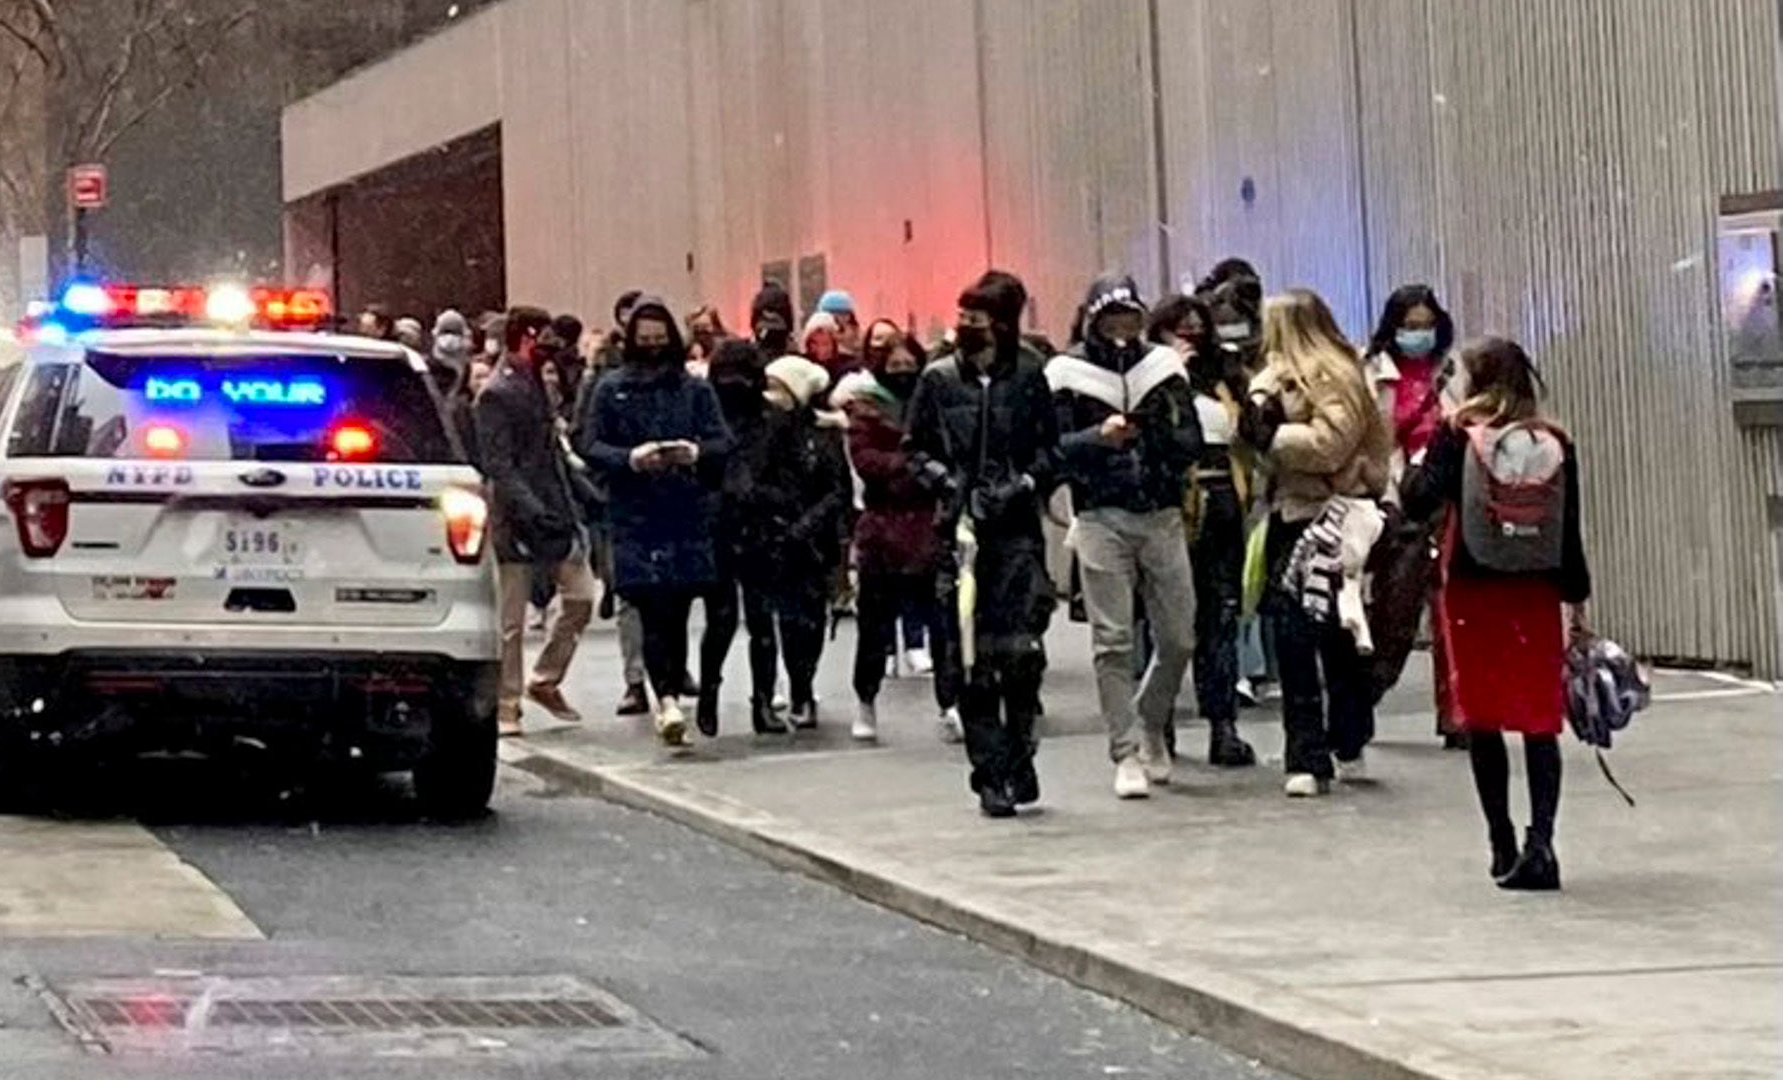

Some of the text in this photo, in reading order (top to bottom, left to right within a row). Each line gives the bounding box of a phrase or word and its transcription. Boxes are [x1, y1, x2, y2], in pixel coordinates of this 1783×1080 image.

[146, 377, 327, 404] DO YOUR
[106, 466, 422, 490] NYPD POLICE
